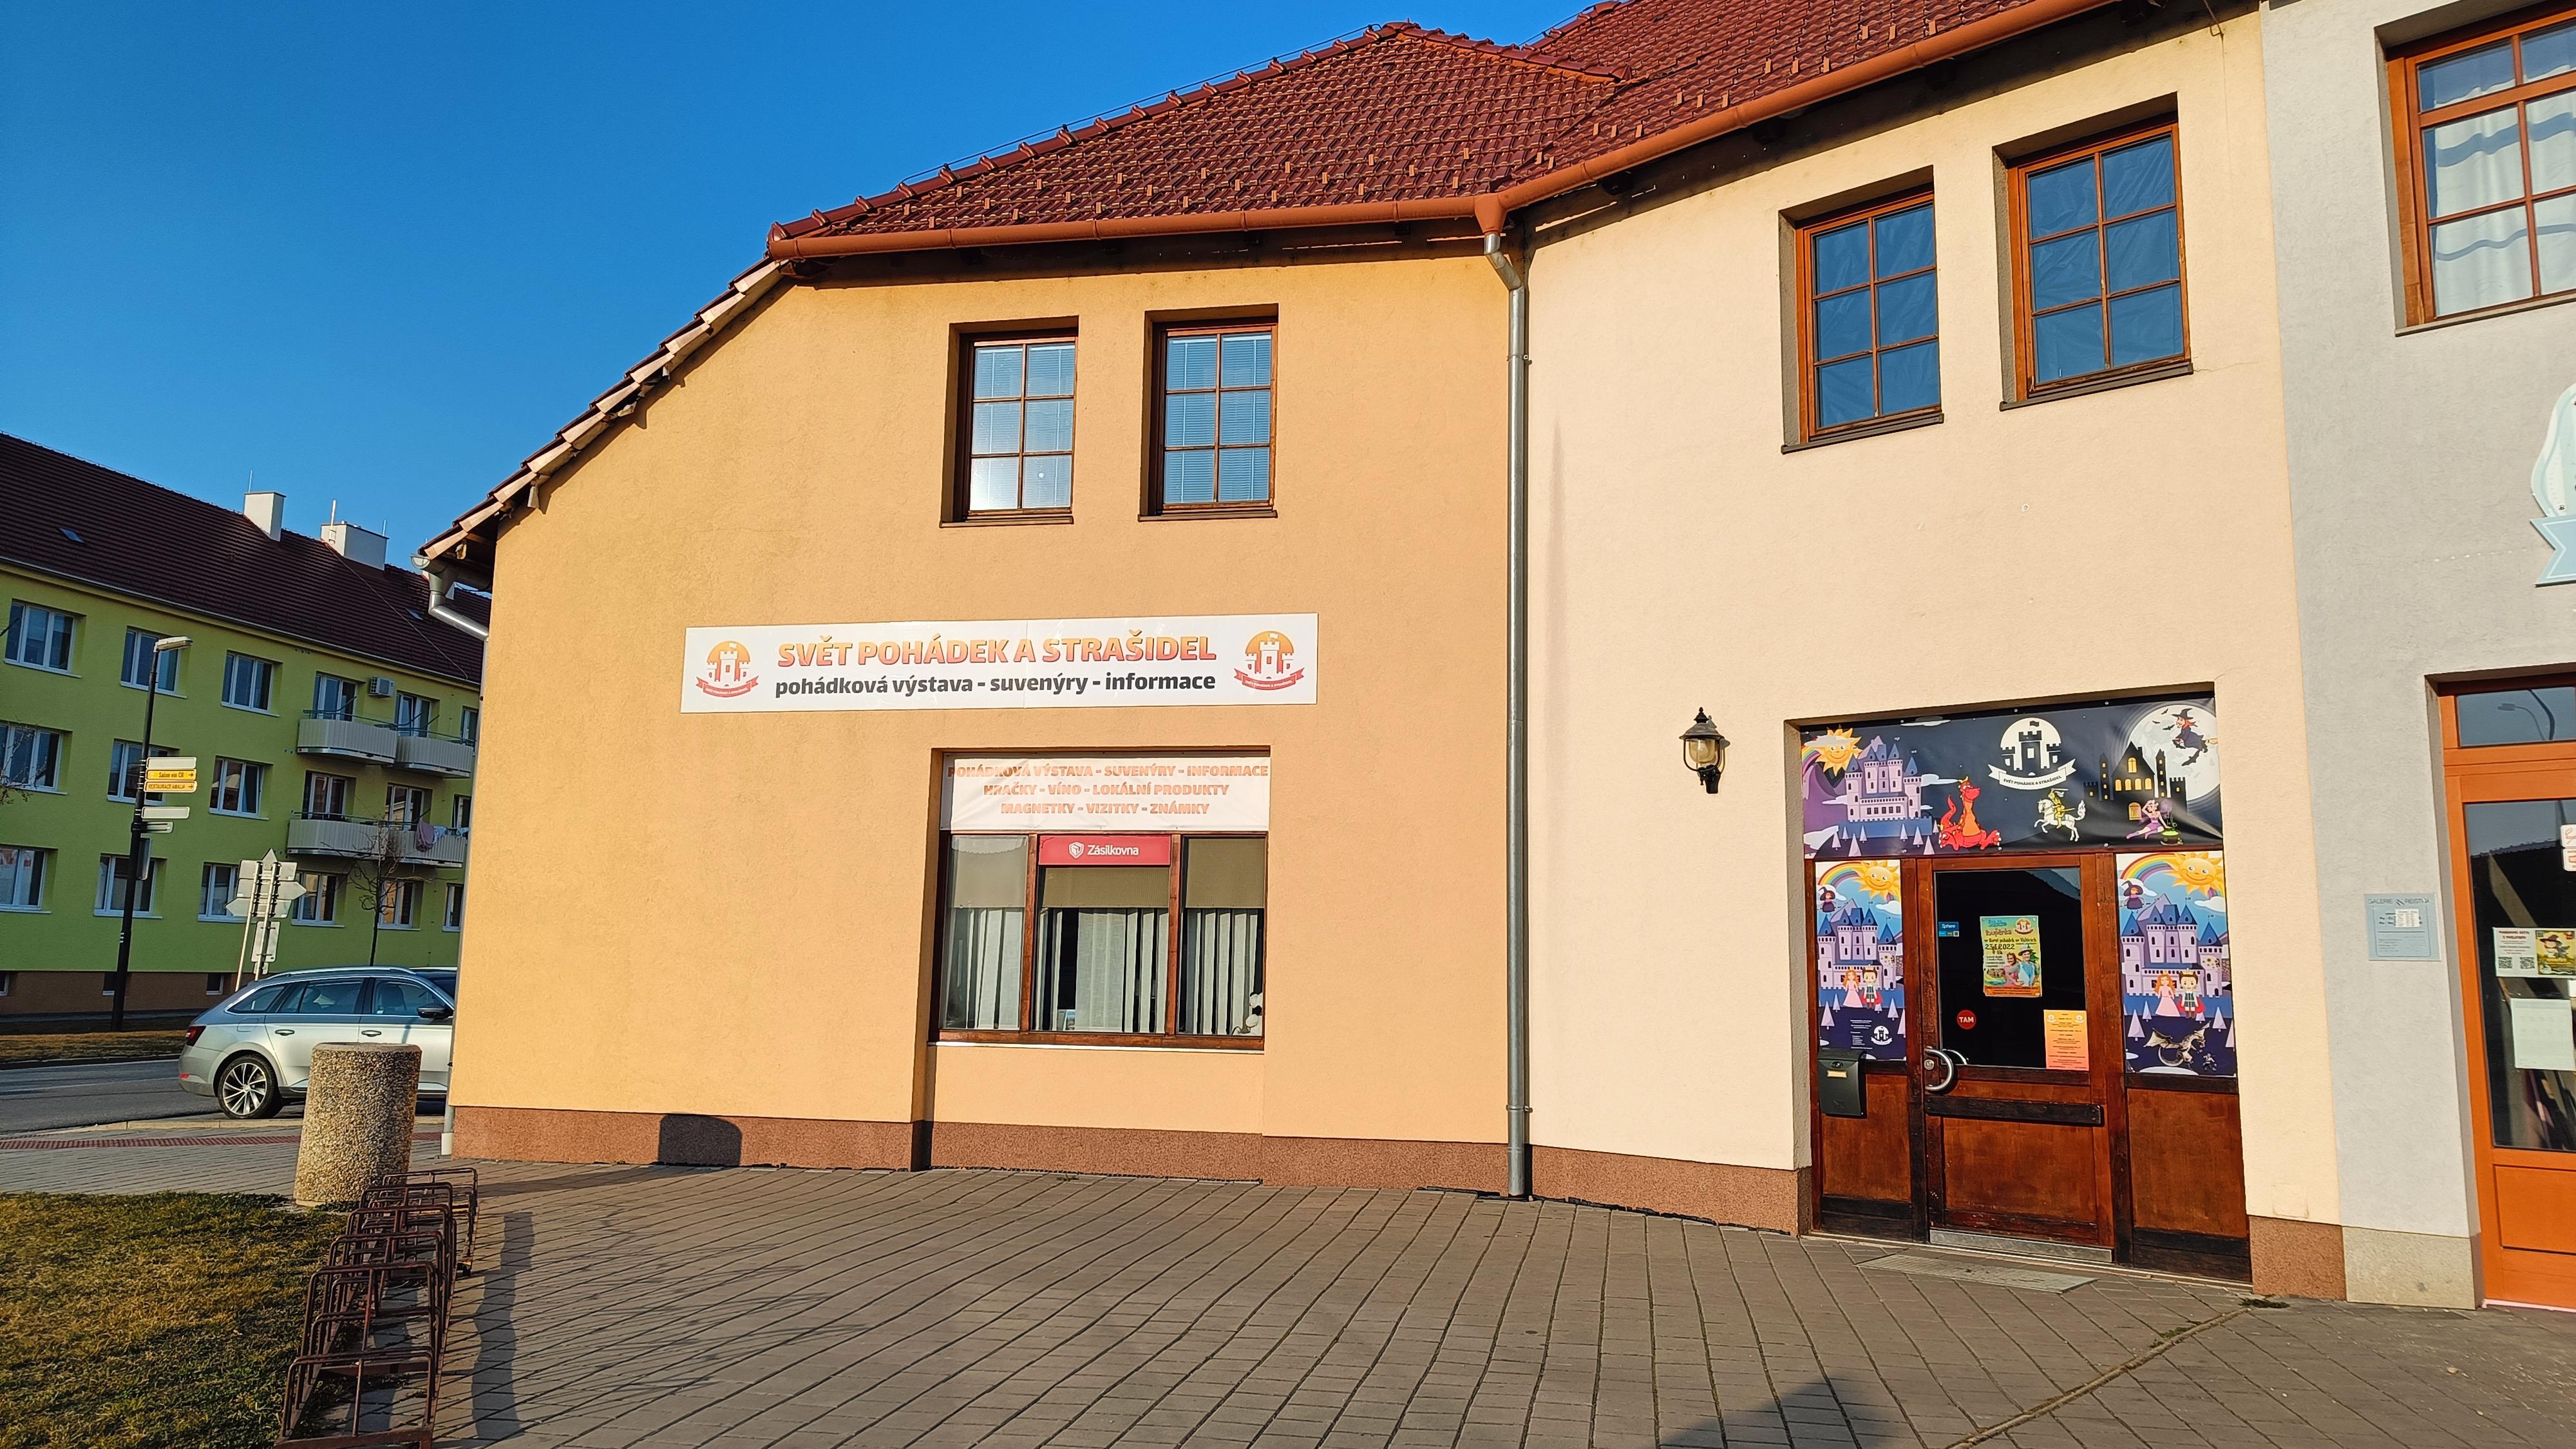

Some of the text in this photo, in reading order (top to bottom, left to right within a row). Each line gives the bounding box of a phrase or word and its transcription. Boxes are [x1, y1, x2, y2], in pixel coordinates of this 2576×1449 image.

[778, 629, 1217, 667] SVĚT POHÁDEK A STRAŠIDEL
[775, 676, 888, 698] pohádková
[893, 674, 973, 697] výstava
[990, 672, 1088, 695] suvenýry
[1105, 672, 1216, 691] informace
[947, 764, 1031, 777] POHÁDKOVÁ
[1033, 763, 1093, 777] VÝSTAVA
[1104, 763, 1176, 777] SUVENÝRY
[1187, 766, 1269, 777] INFORMACE
[2039, 775, 2061, 784] STRAŠIDEL
[983, 782, 1037, 795] HRAČKY
[1048, 781, 1081, 795] VÍNO
[1092, 782, 1151, 795] LOKÁLNÍ
[1153, 784, 1229, 795] PRODUKTY
[1001, 803, 1075, 814] MAGNETKY
[1086, 803, 1140, 814] VIZITKY
[1150, 800, 1209, 815] ZNÁMKY
[1087, 845, 1139, 855] Zásilkovna
